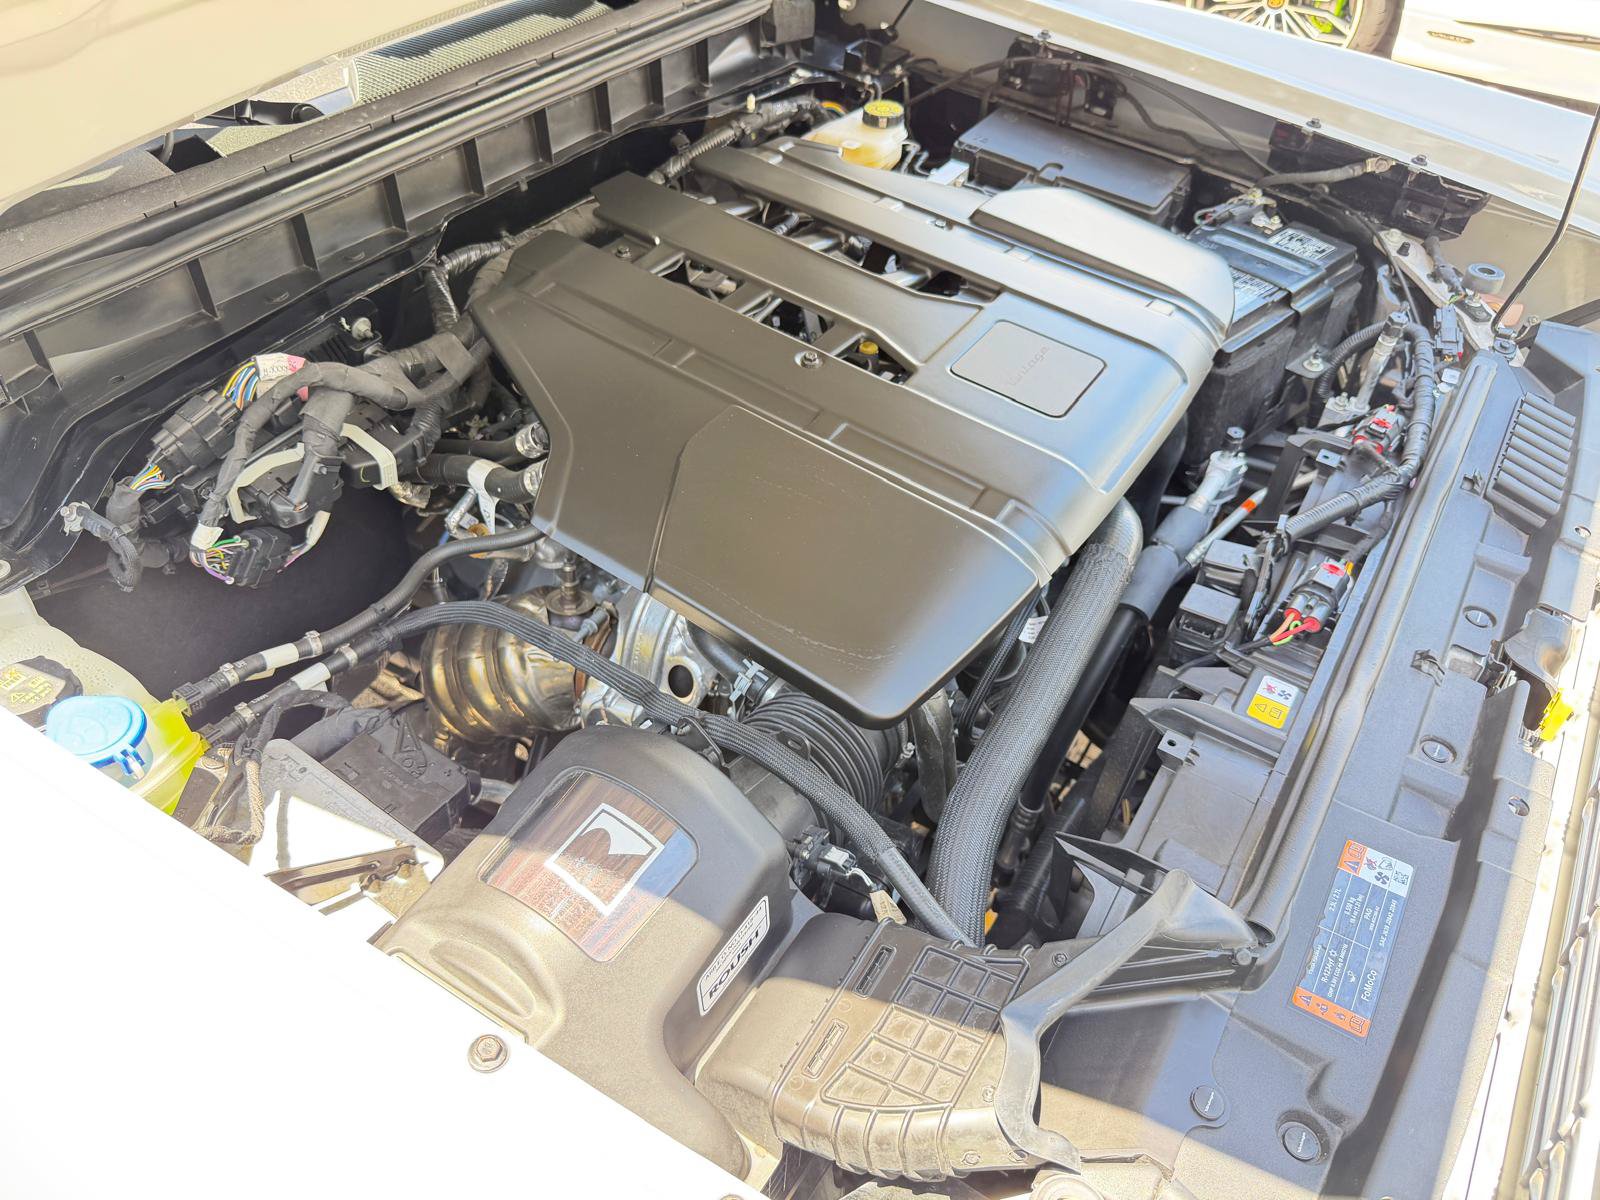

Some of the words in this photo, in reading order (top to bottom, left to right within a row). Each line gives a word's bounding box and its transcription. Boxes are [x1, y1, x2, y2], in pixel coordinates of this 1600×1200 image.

[709, 928, 758, 999] ROUSH
[1320, 957, 1335, 983] R-1234yf
[1360, 968, 1377, 1001] FoMoCo
